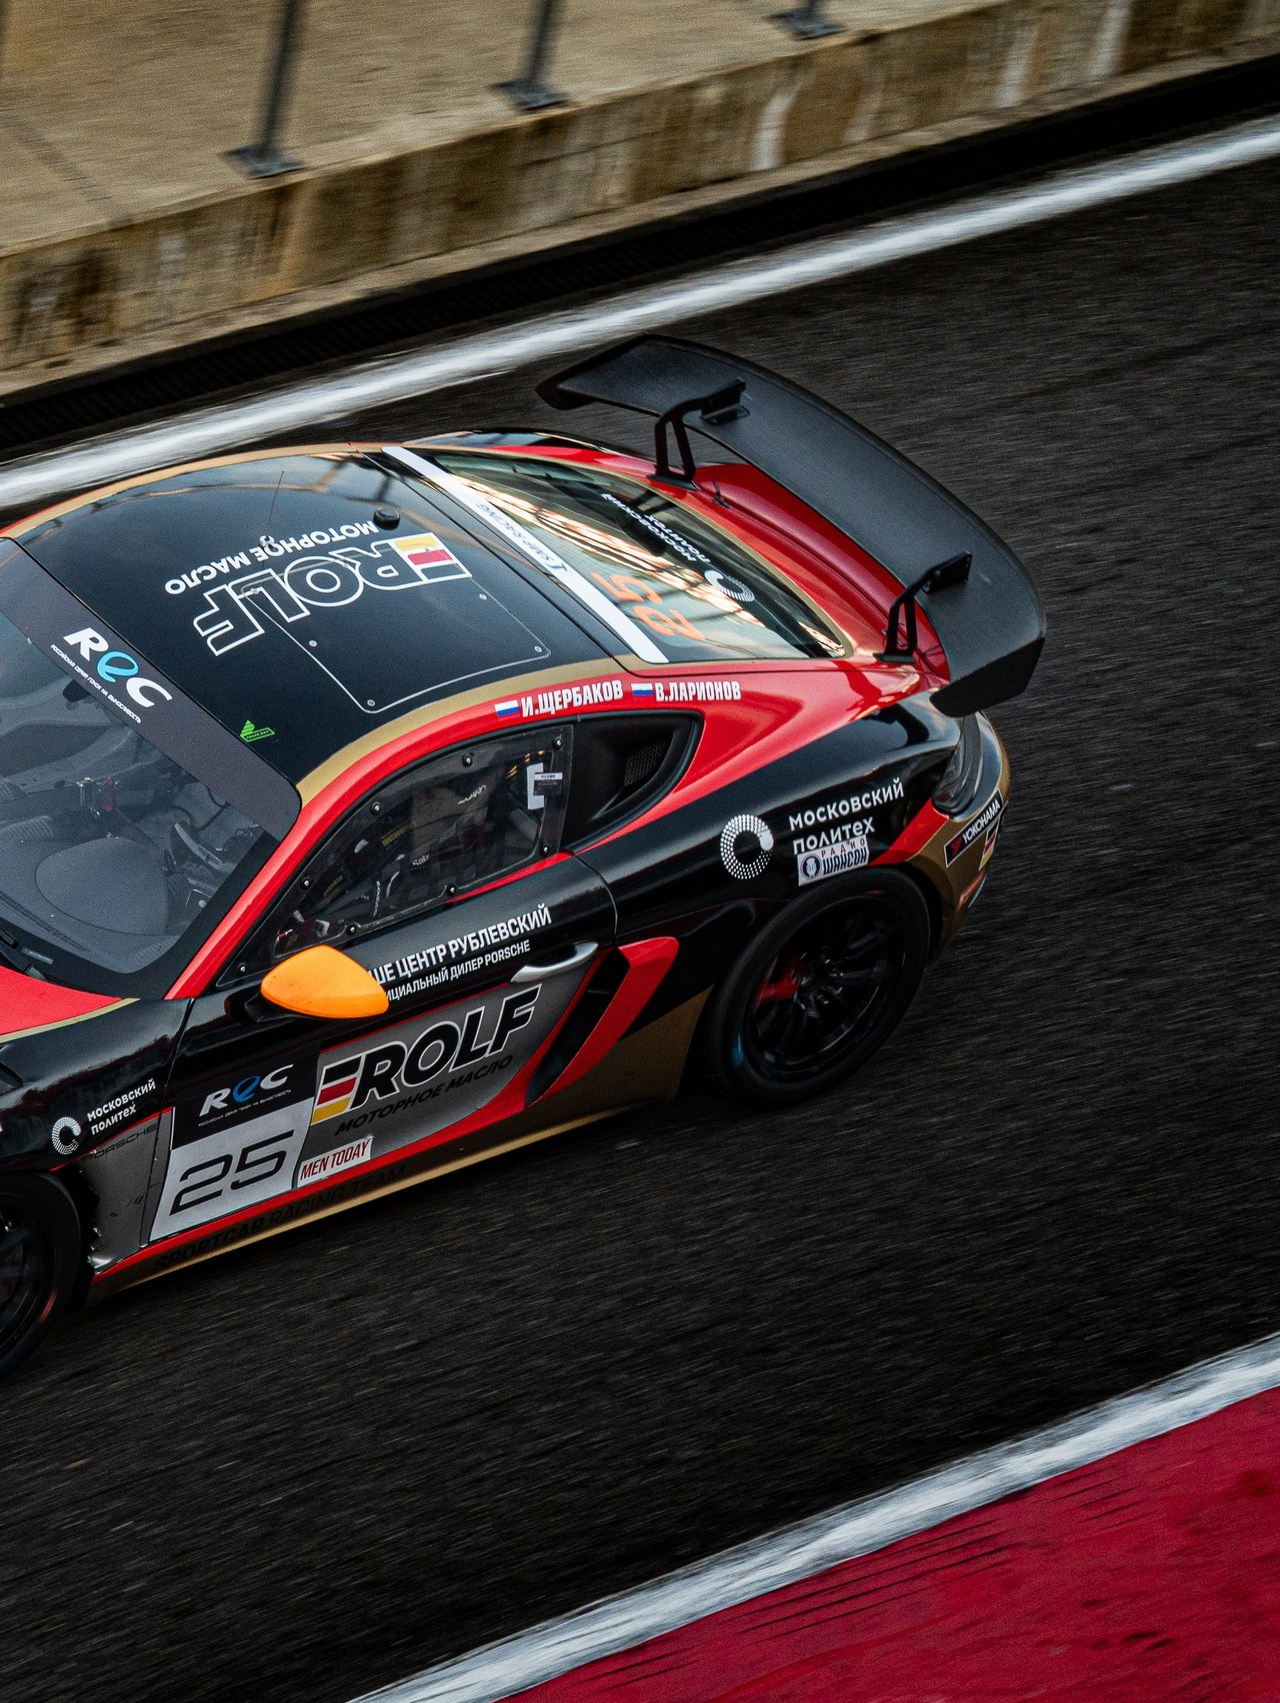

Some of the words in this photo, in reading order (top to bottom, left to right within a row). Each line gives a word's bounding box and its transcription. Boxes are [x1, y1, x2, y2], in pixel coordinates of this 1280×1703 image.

[249, 519, 380, 560] МОТОРНОЕ
[164, 550, 252, 595] МАСЛО
[193, 539, 425, 656] ROLF
[590, 571, 706, 640] 25
[521, 679, 624, 718] И.ЩЕРБАКОВ
[654, 680, 742, 703] В.ЛАРИОНОВ
[962, 799, 1001, 844] YOKOHAMA
[821, 838, 865, 858] РАДИО
[823, 846, 868, 876] ШАНСОН
[395, 945, 448, 979] ЦЕНТР
[448, 902, 552, 959] РУБЛЕВСКИЙ
[450, 956, 484, 981] ДИЛЕР
[485, 939, 531, 967] PORSCHE
[346, 983, 543, 1115] ROLF
[334, 1081, 447, 1136] МОТОРНОЕ
[444, 1054, 515, 1092] МАСЛО
[169, 1128, 295, 1217] 25
[299, 1157, 328, 1182] MEN
[330, 1139, 371, 1173] TODAY
